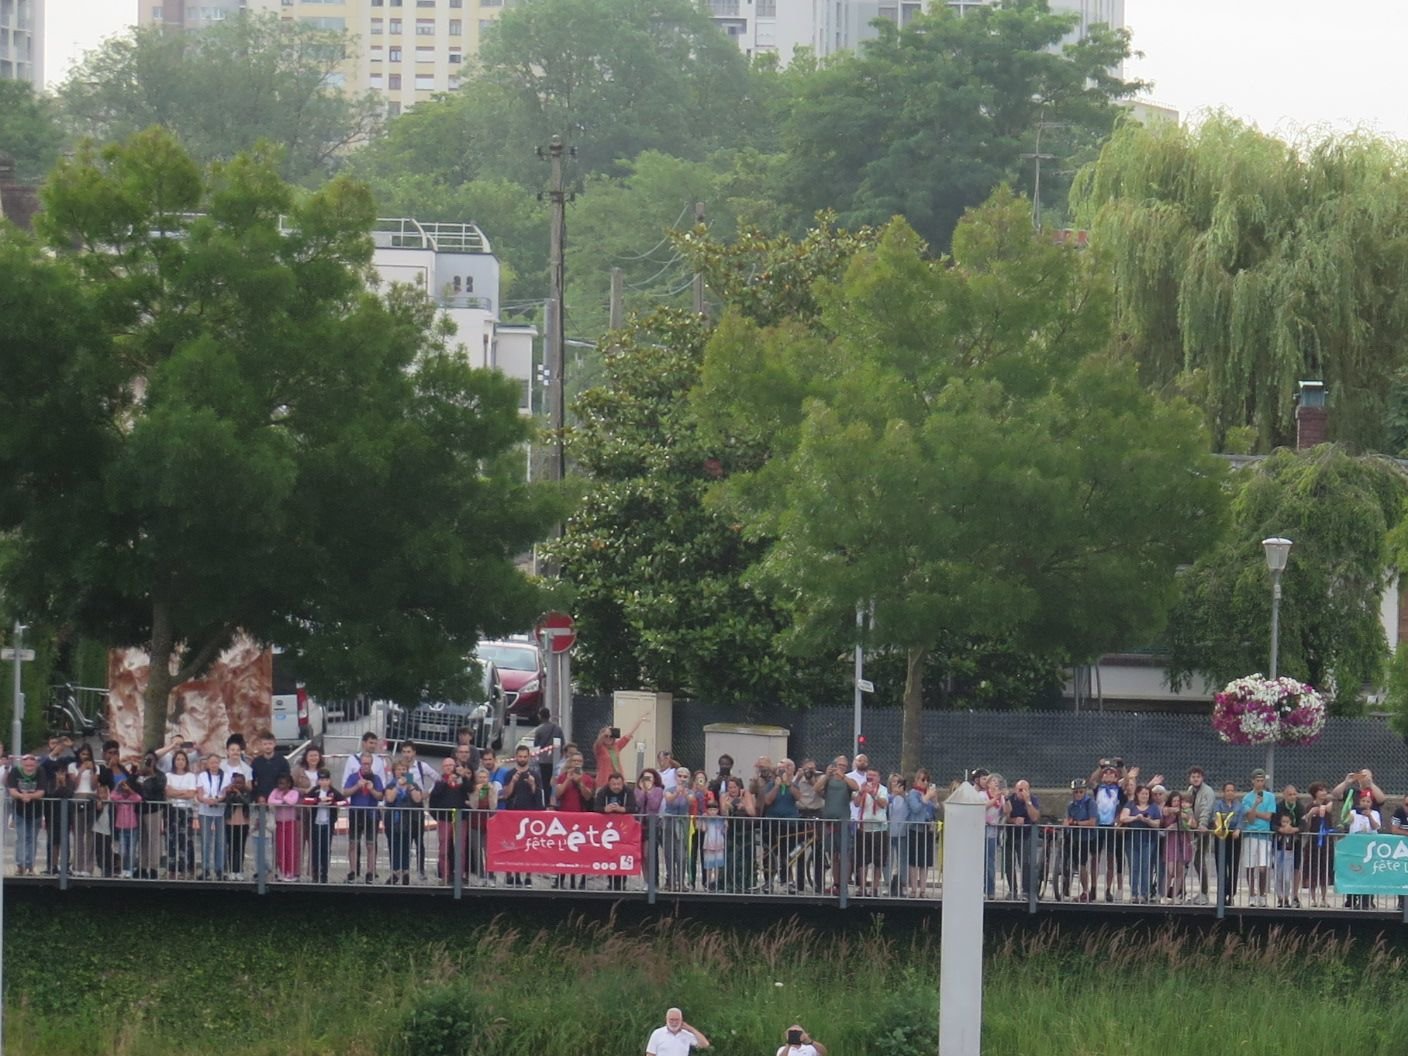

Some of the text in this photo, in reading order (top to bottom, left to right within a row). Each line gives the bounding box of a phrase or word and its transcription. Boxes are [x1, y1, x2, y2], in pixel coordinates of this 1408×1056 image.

[516, 817, 567, 840] SOA
[524, 837, 556, 852] fête
[1372, 860, 1401, 875] fête
